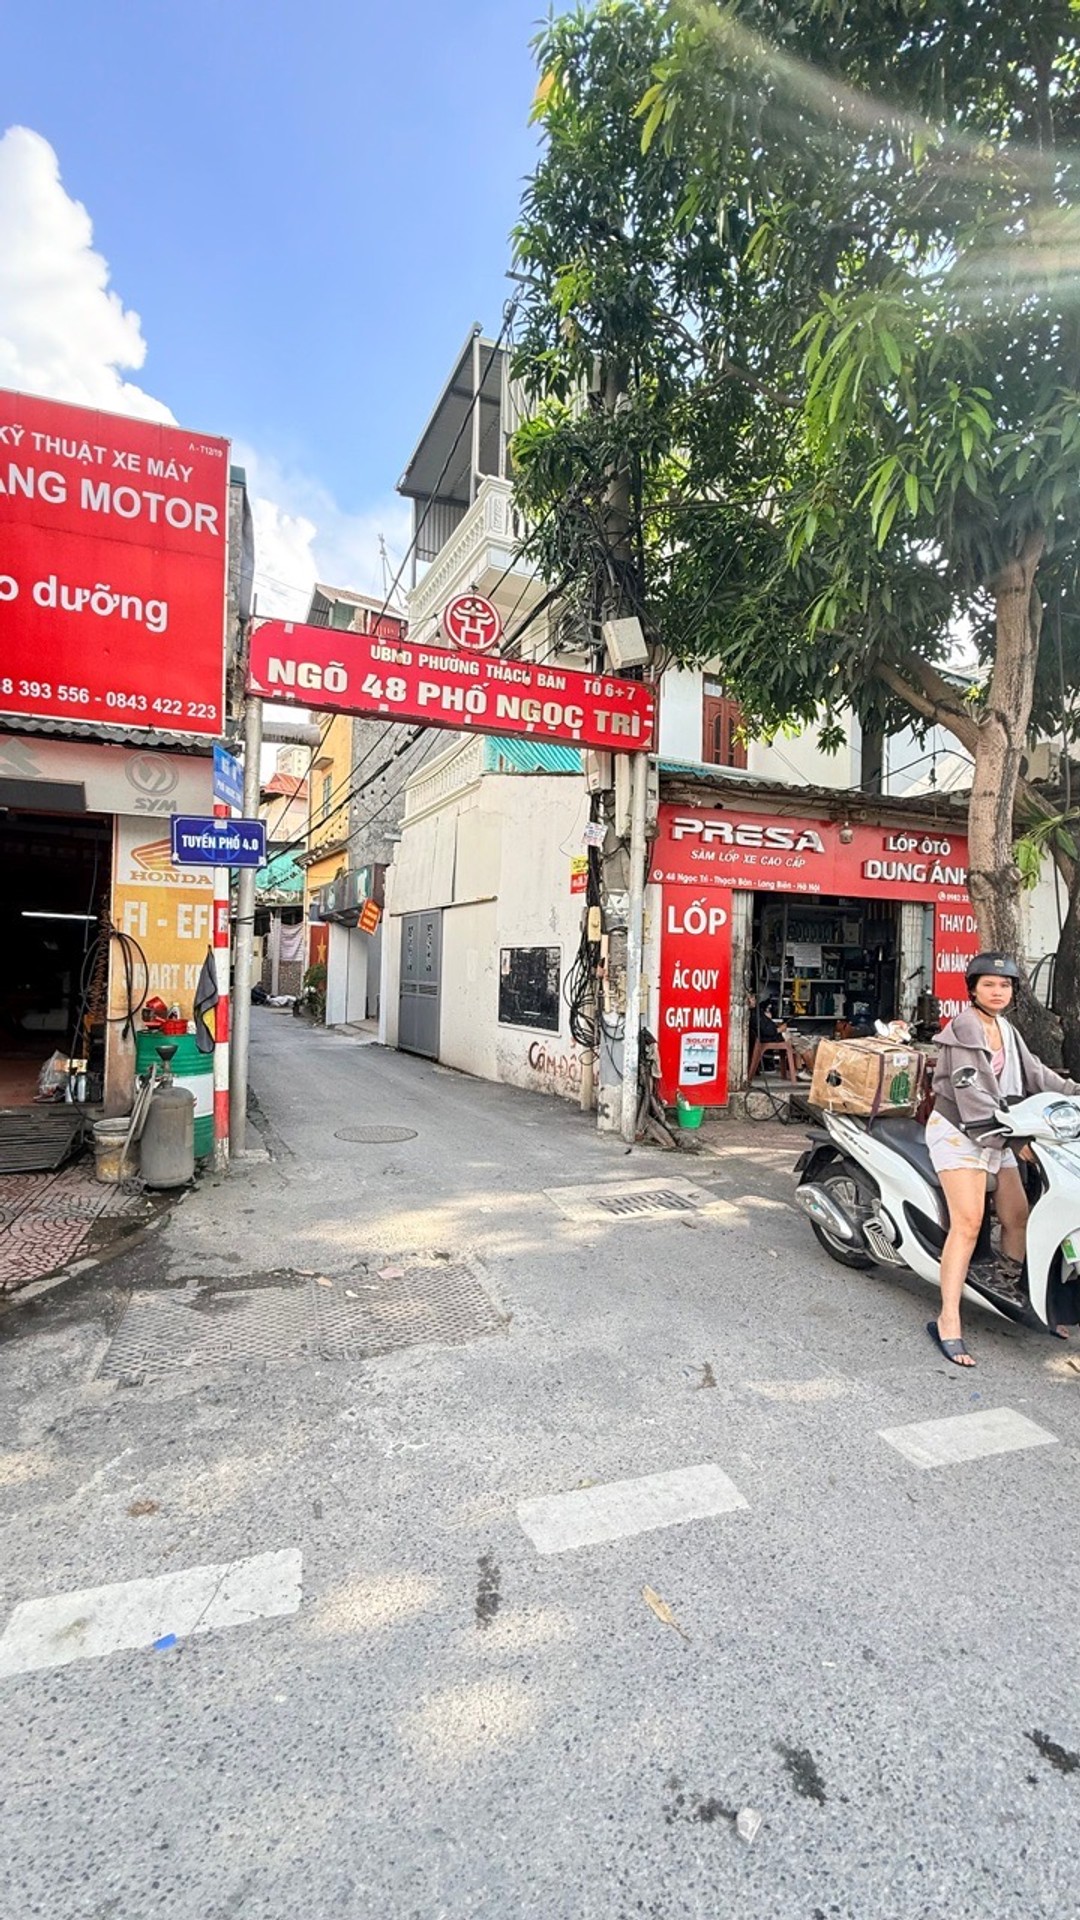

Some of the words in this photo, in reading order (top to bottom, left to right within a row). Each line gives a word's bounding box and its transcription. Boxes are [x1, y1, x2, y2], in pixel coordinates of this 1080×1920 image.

[31, 431, 108, 466] THUẬT
[112, 449, 141, 473] XE
[147, 455, 194, 484] MÁY
[81, 478, 219, 536] MOTOR
[32, 574, 169, 634] dưỡng
[418, 653, 480, 676] PHƯỜNG
[18, 680, 52, 700] 393
[57, 685, 90, 704] 556
[106, 691, 147, 711] 0843
[152, 699, 182, 716] 422
[187, 702, 217, 720] 223
[267, 656, 348, 694] NGÕ
[361, 673, 407, 703] 48
[417, 681, 490, 716] PHỐ
[496, 694, 584, 731] NGỌC
[593, 709, 640, 738] TRÌ
[134, 798, 177, 813] SYM
[182, 832, 215, 849] TUYẾN
[219, 834, 240, 850] PHỐ
[242, 838, 260, 851] 4.0
[672, 817, 825, 853] PRESA
[887, 832, 918, 852] LỐP
[719, 849, 740, 863] LỐP
[743, 854, 757, 865] XE
[760, 855, 782, 867] CAO
[785, 855, 806, 869] CẤP
[866, 860, 927, 882] DUNG
[130, 870, 213, 885] HONDA
[758, 880, 775, 890] Long
[124, 901, 148, 937] FI
[667, 897, 727, 936] LỐP
[940, 913, 966, 932] THAY
[692, 968, 719, 992] QUY
[665, 1007, 691, 1032] GẠT
[692, 1005, 722, 1029] MƯA
